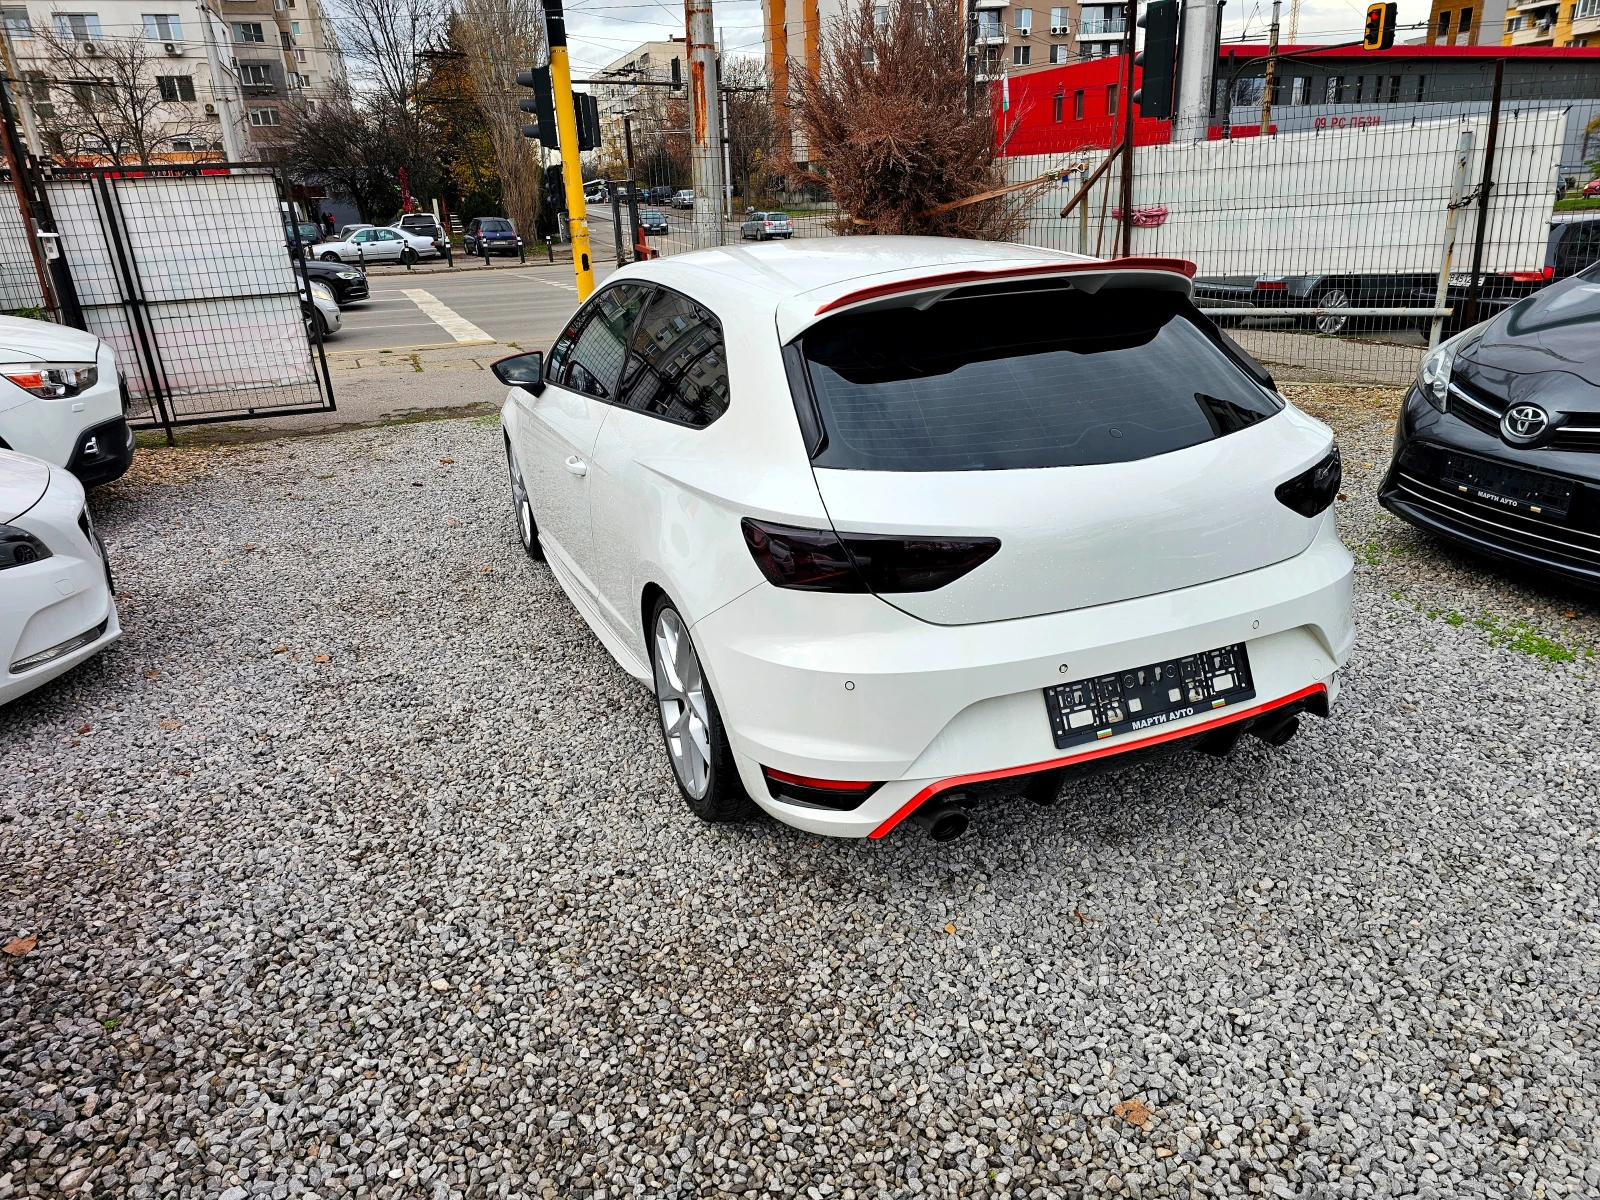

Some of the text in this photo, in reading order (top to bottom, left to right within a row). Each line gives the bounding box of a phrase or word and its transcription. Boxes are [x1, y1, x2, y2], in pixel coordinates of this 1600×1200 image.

[1478, 491, 1517, 507] МАРТИ АУТО
[1132, 707, 1194, 730] МАРТИ АУТО
